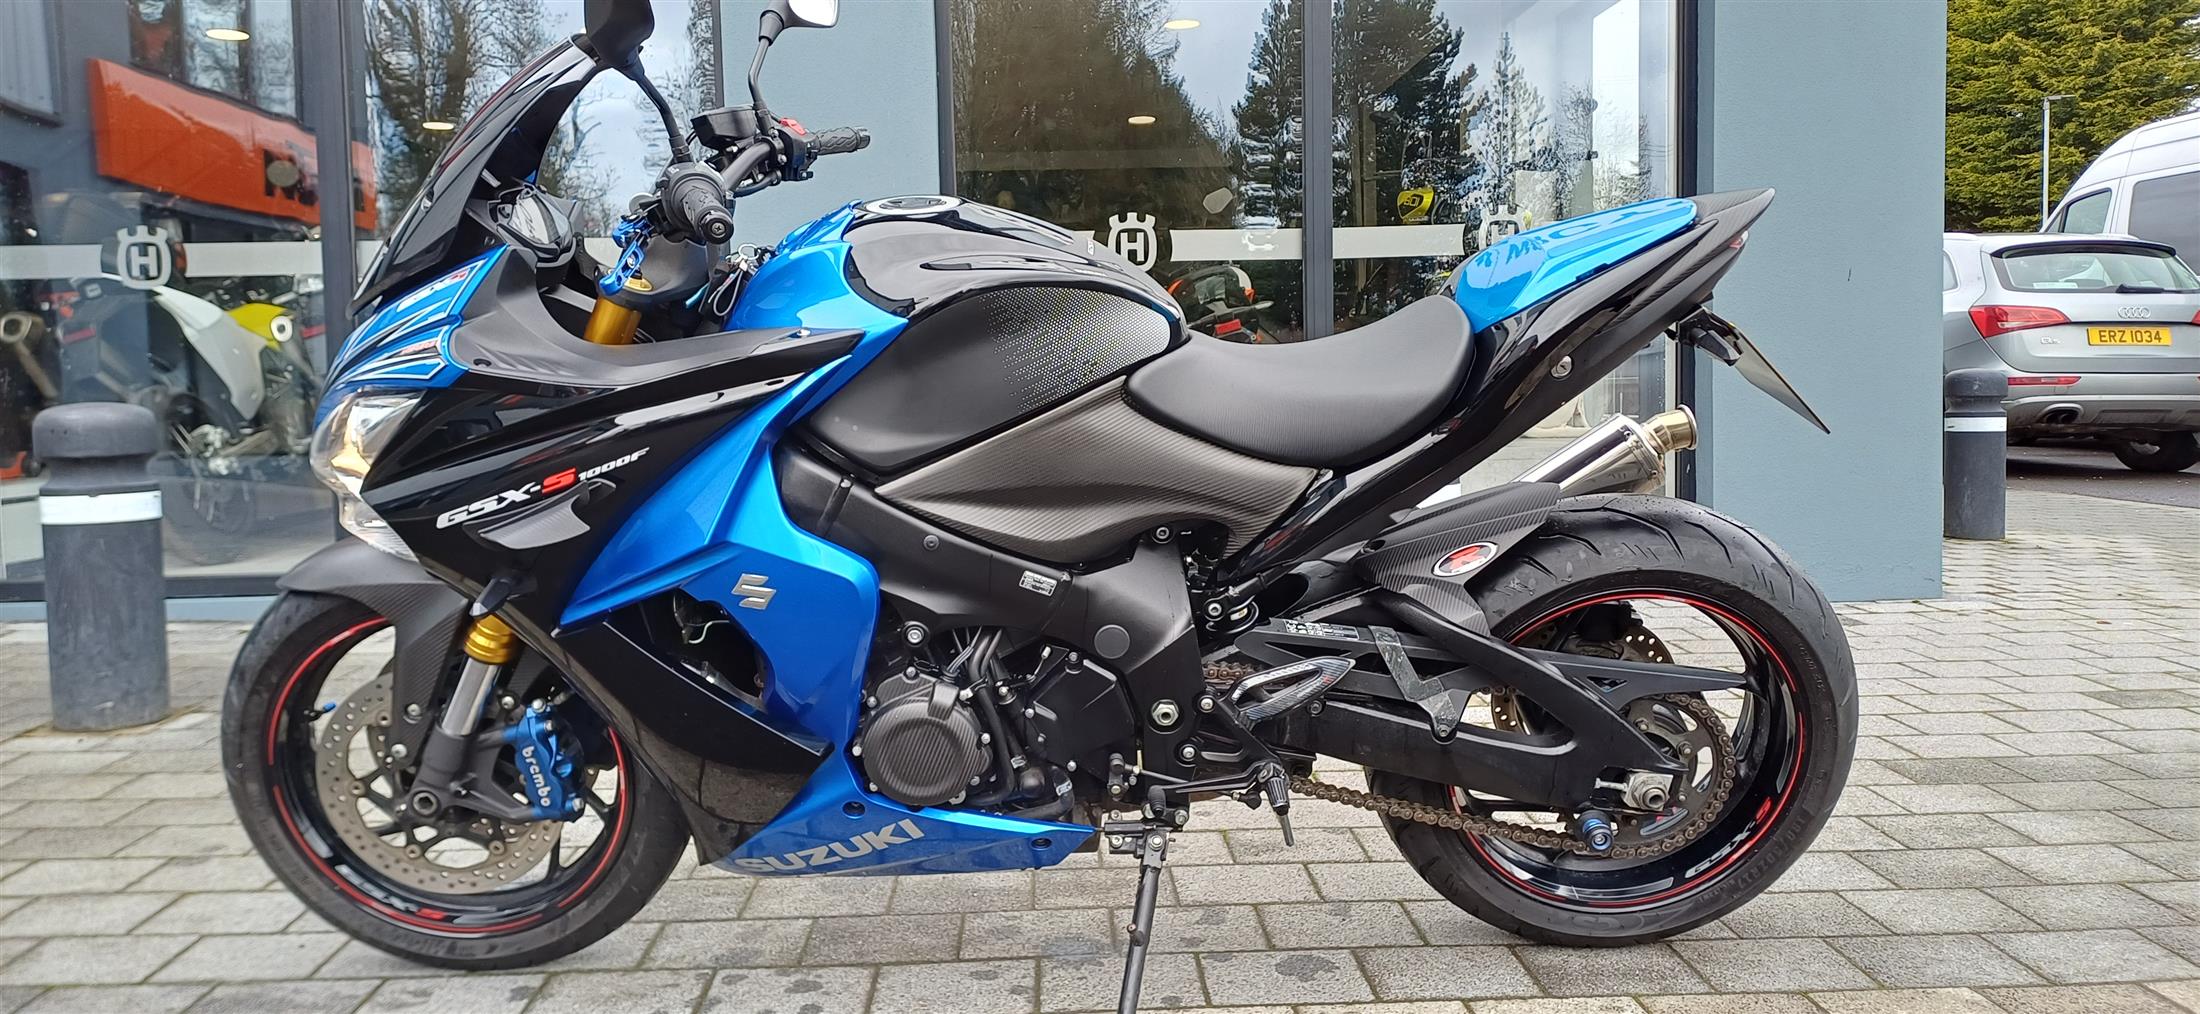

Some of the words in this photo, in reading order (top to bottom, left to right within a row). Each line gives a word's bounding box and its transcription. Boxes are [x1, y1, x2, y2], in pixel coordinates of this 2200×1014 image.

[2098, 329, 2127, 343] ERZ
[2130, 330, 2162, 344] 1034
[522, 746, 551, 807] brembo
[734, 818, 925, 873] SUZUKI
